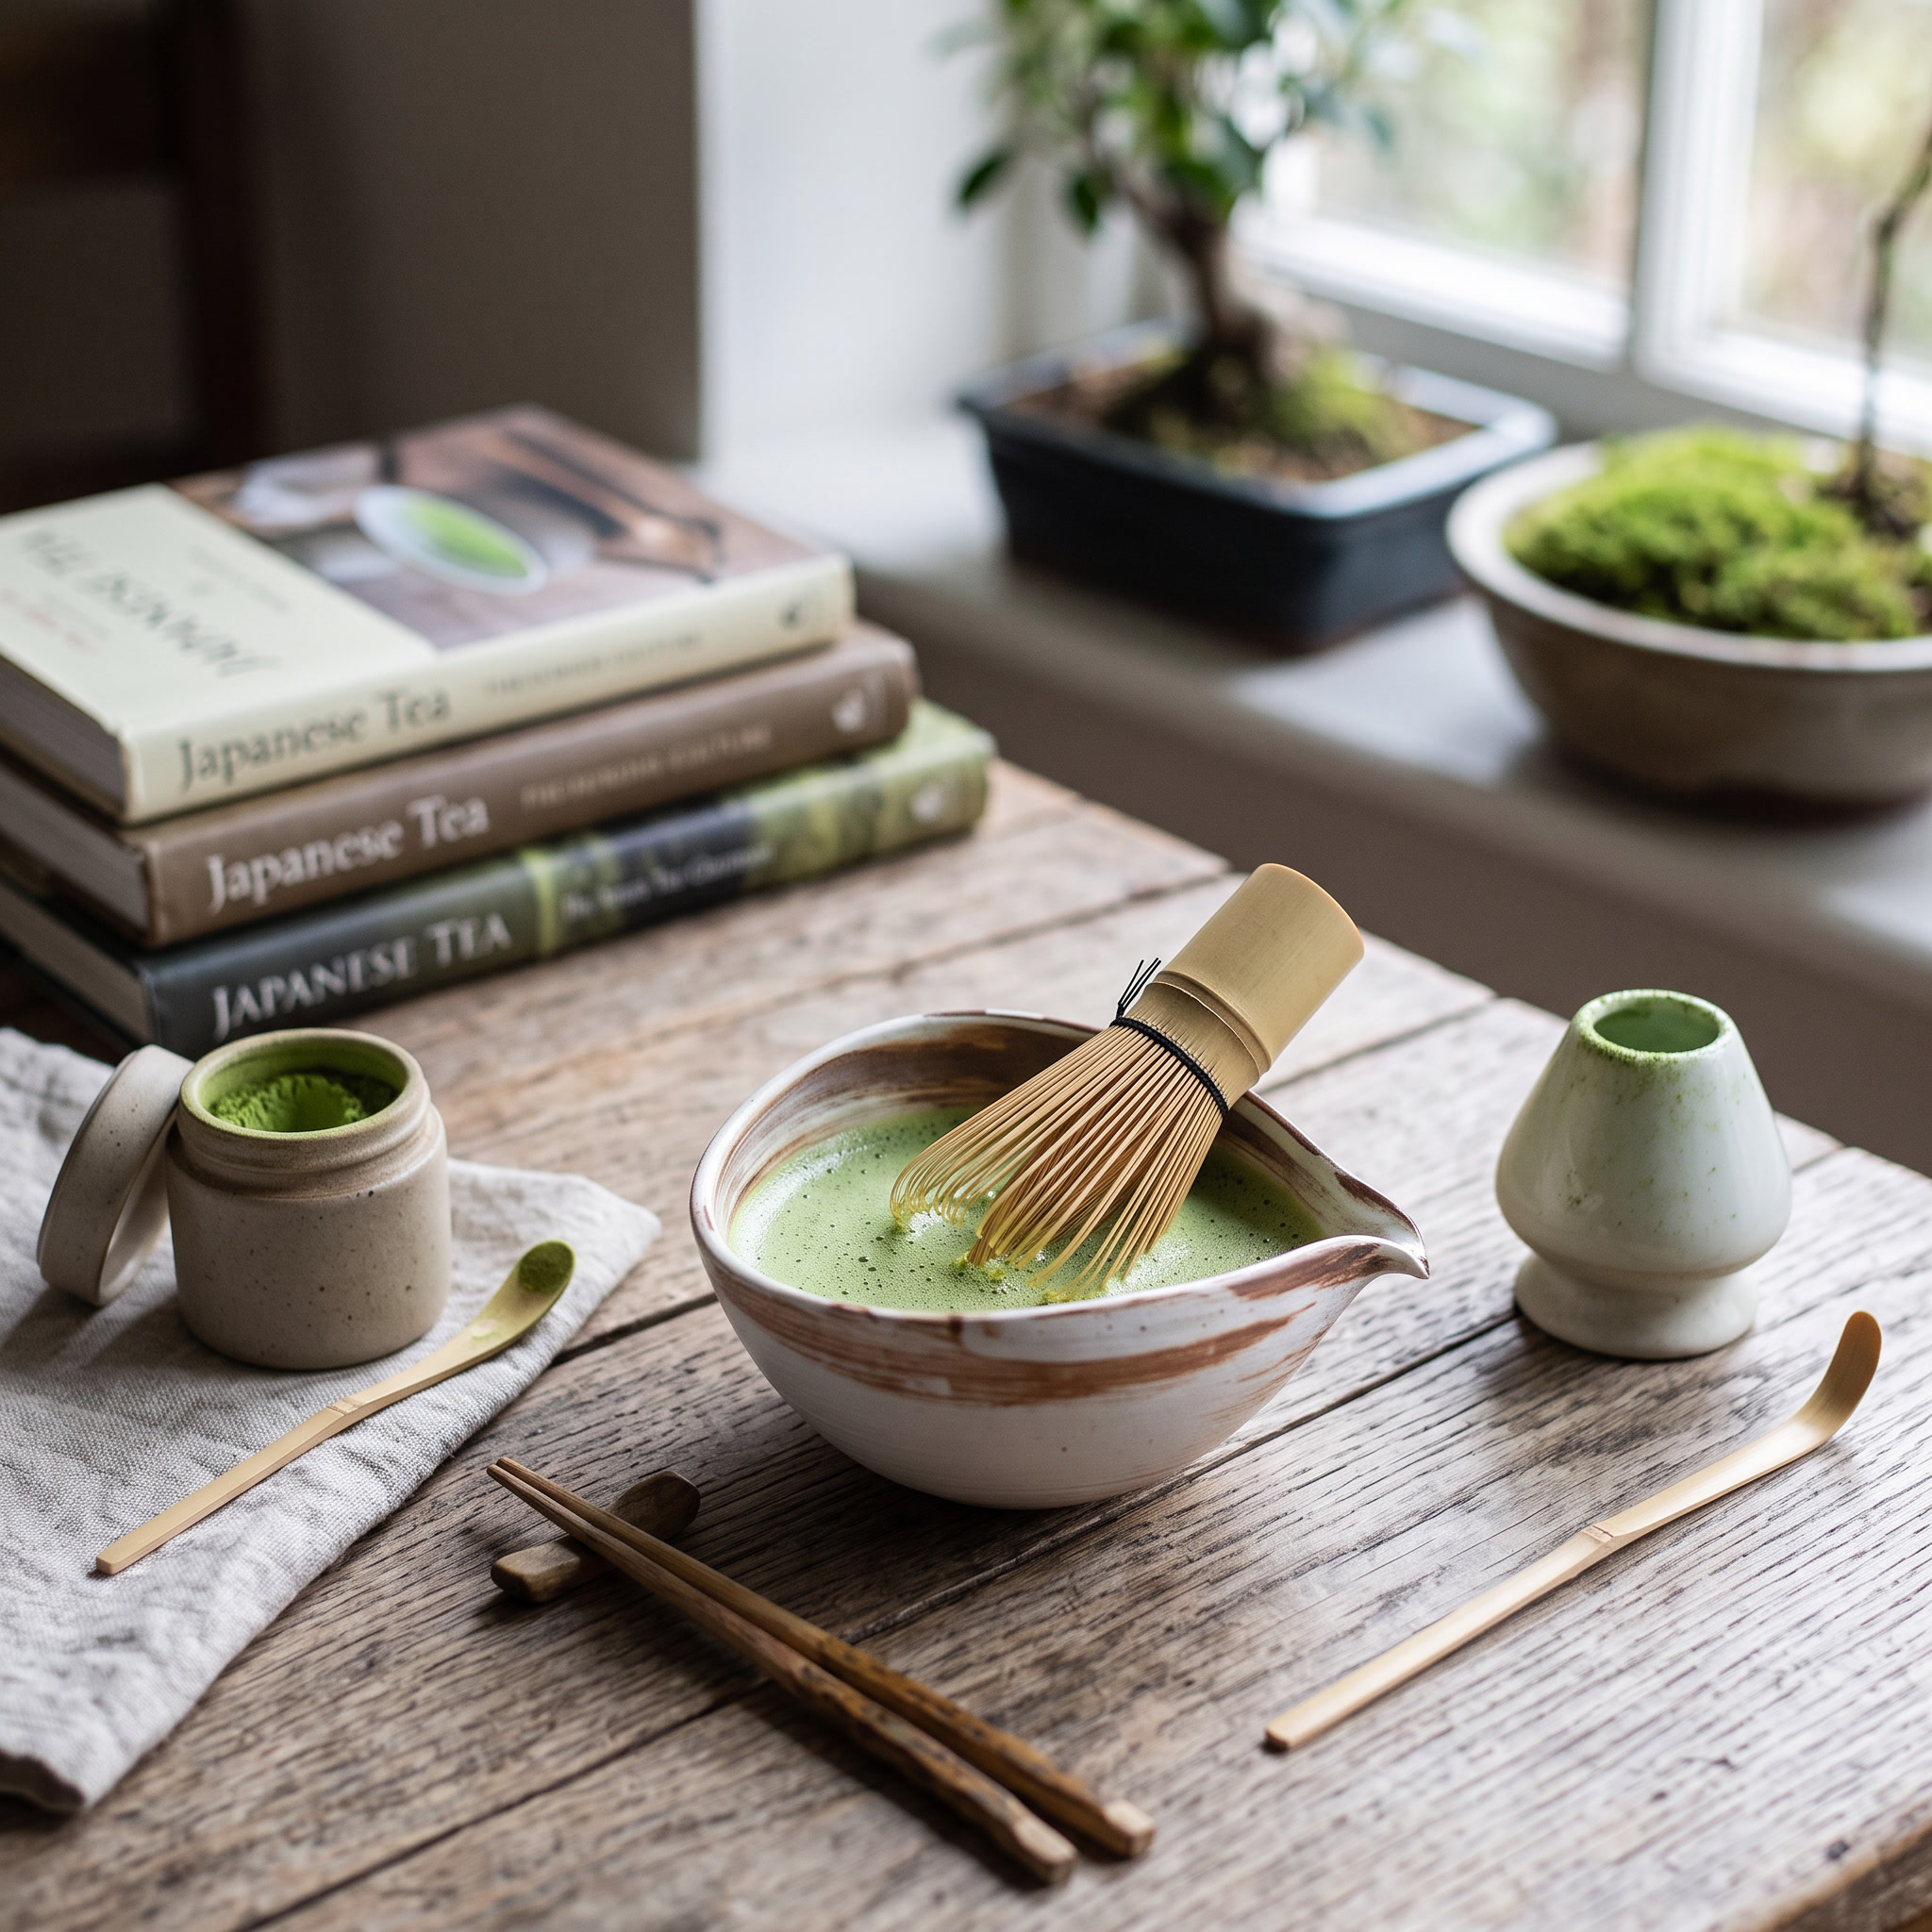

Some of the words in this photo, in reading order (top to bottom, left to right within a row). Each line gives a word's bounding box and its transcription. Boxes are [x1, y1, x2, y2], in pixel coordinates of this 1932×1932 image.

[176, 709, 366, 793] Japanese
[376, 687, 452, 732] Tea
[207, 821, 405, 916] Japanese
[407, 794, 490, 849] Tea
[211, 934, 420, 1041] JAPANESE
[425, 911, 514, 967] TEA
